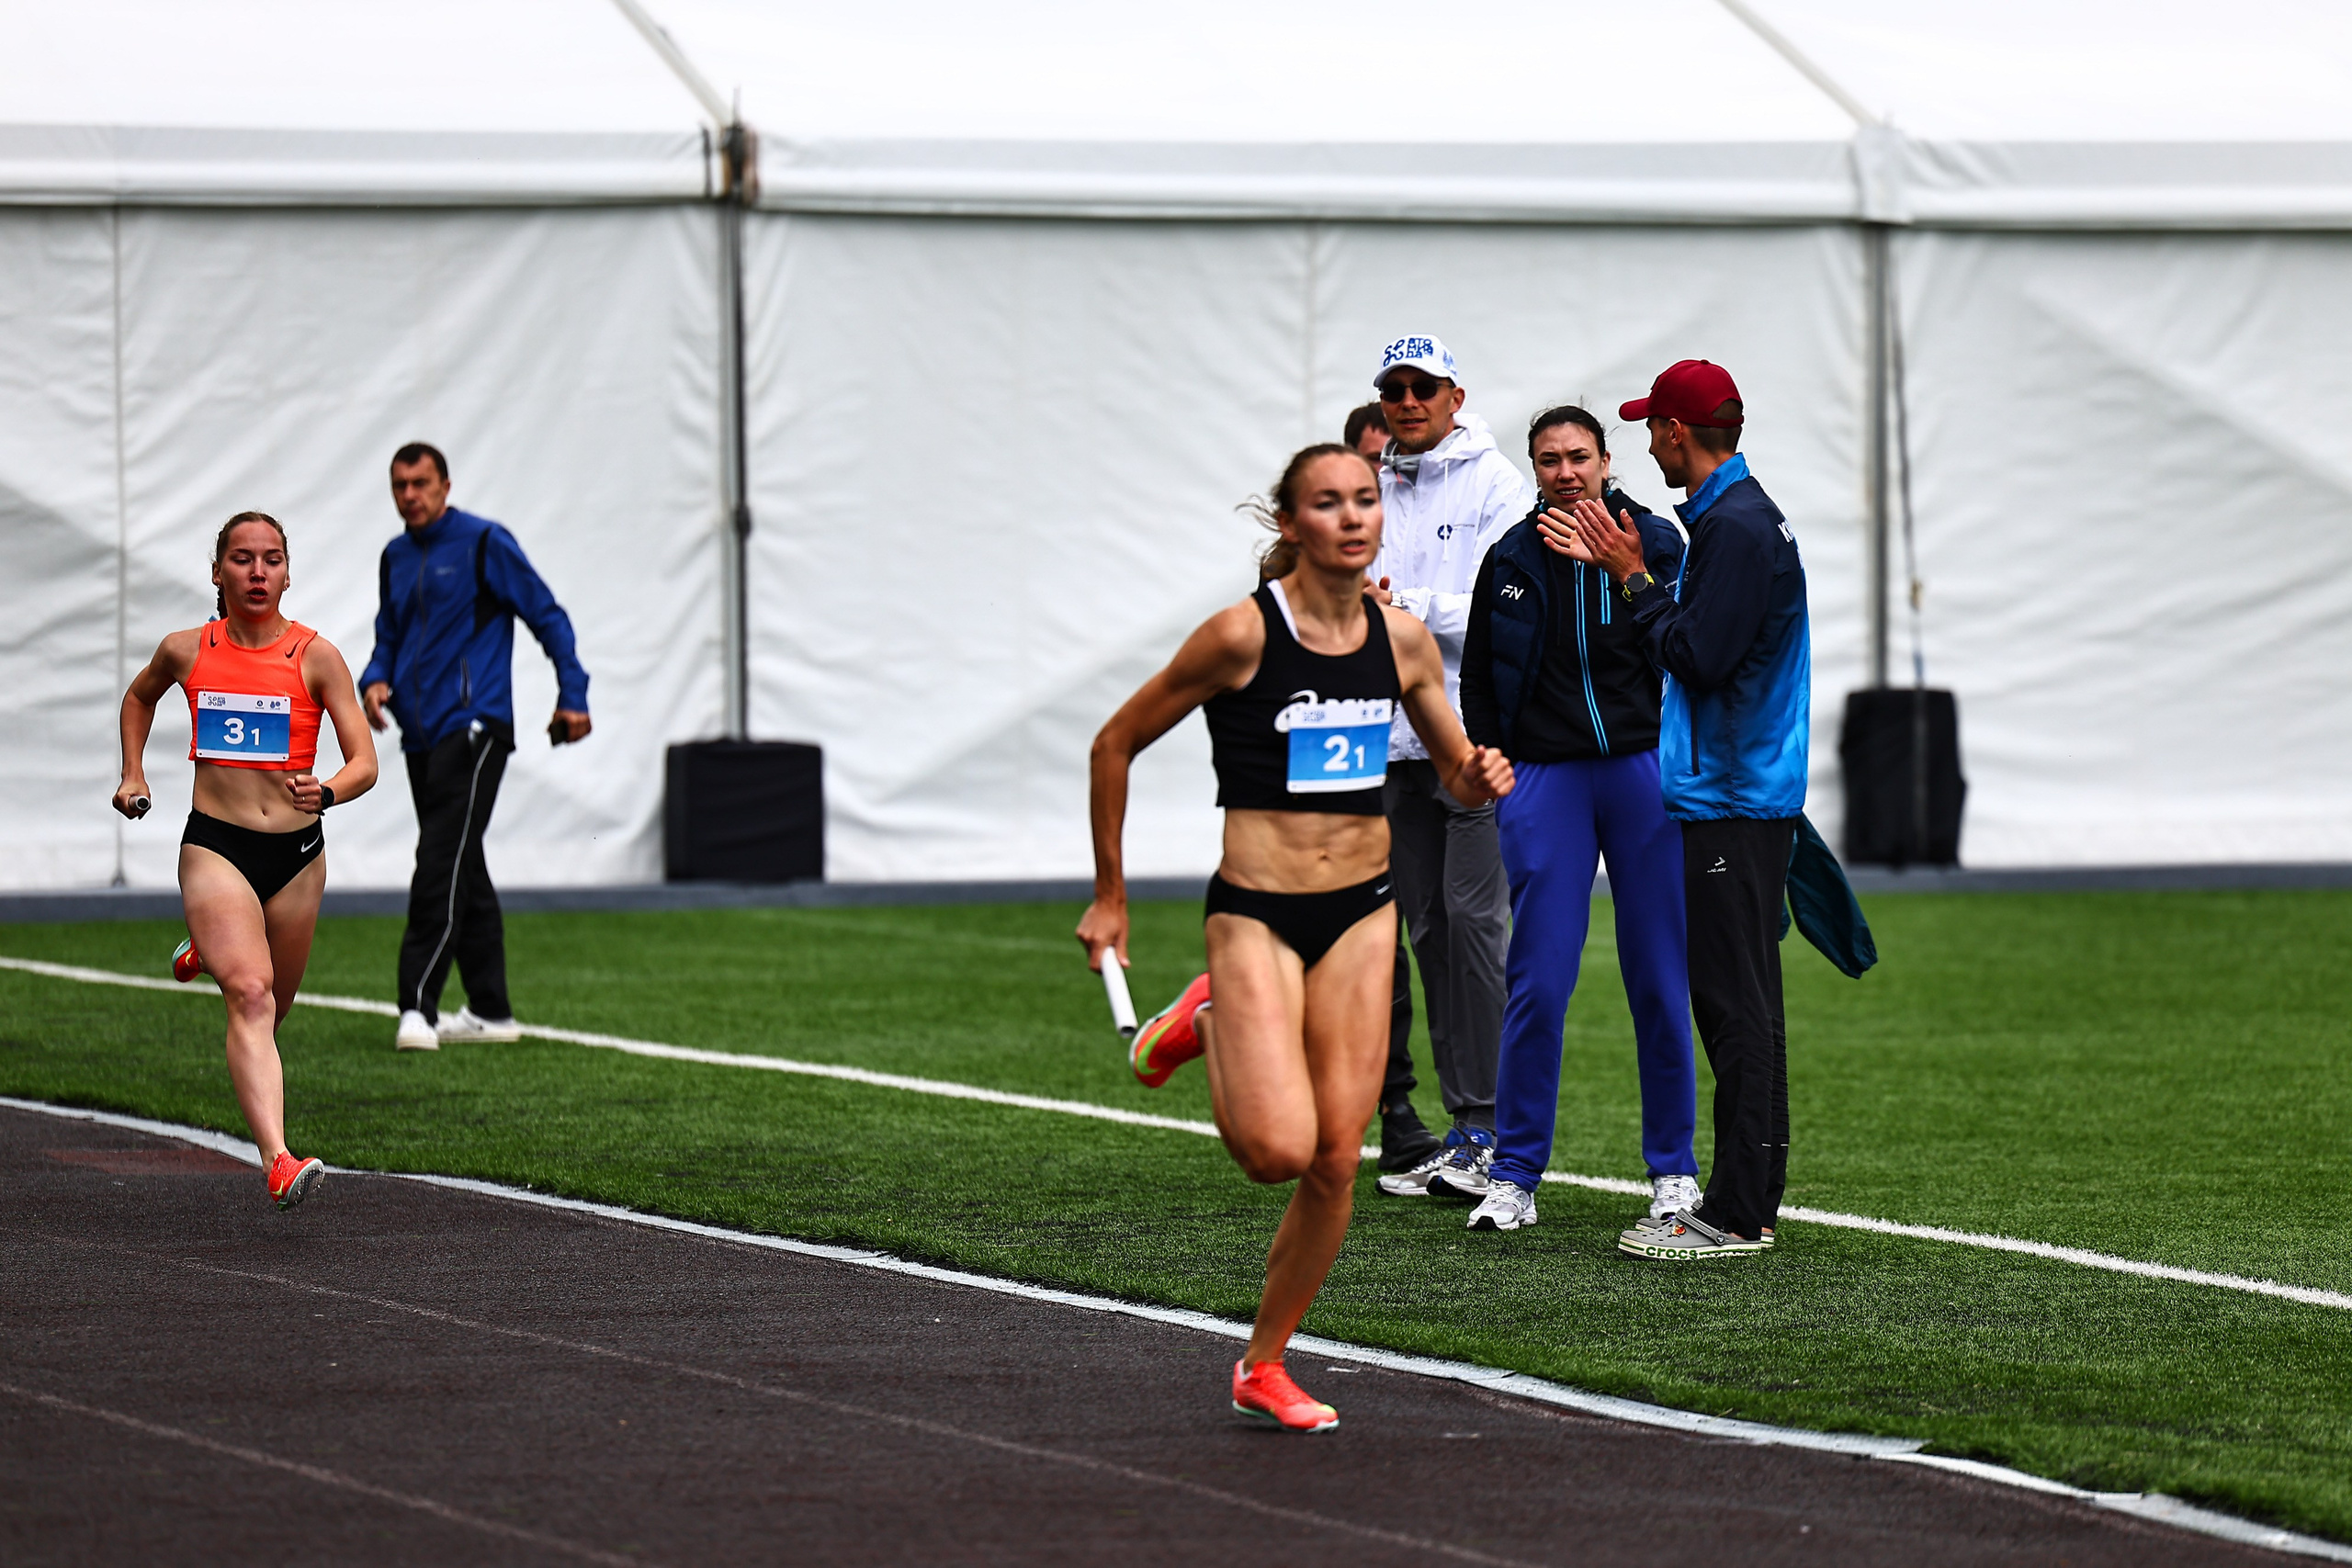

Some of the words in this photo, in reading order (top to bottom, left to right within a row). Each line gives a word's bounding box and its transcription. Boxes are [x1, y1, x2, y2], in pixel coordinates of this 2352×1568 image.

[223, 717, 244, 745] 3
[251, 728, 260, 746] 1
[1323, 734, 1351, 772] 2
[1354, 744, 1365, 770] 1
[1645, 1246, 1698, 1259] crocs
